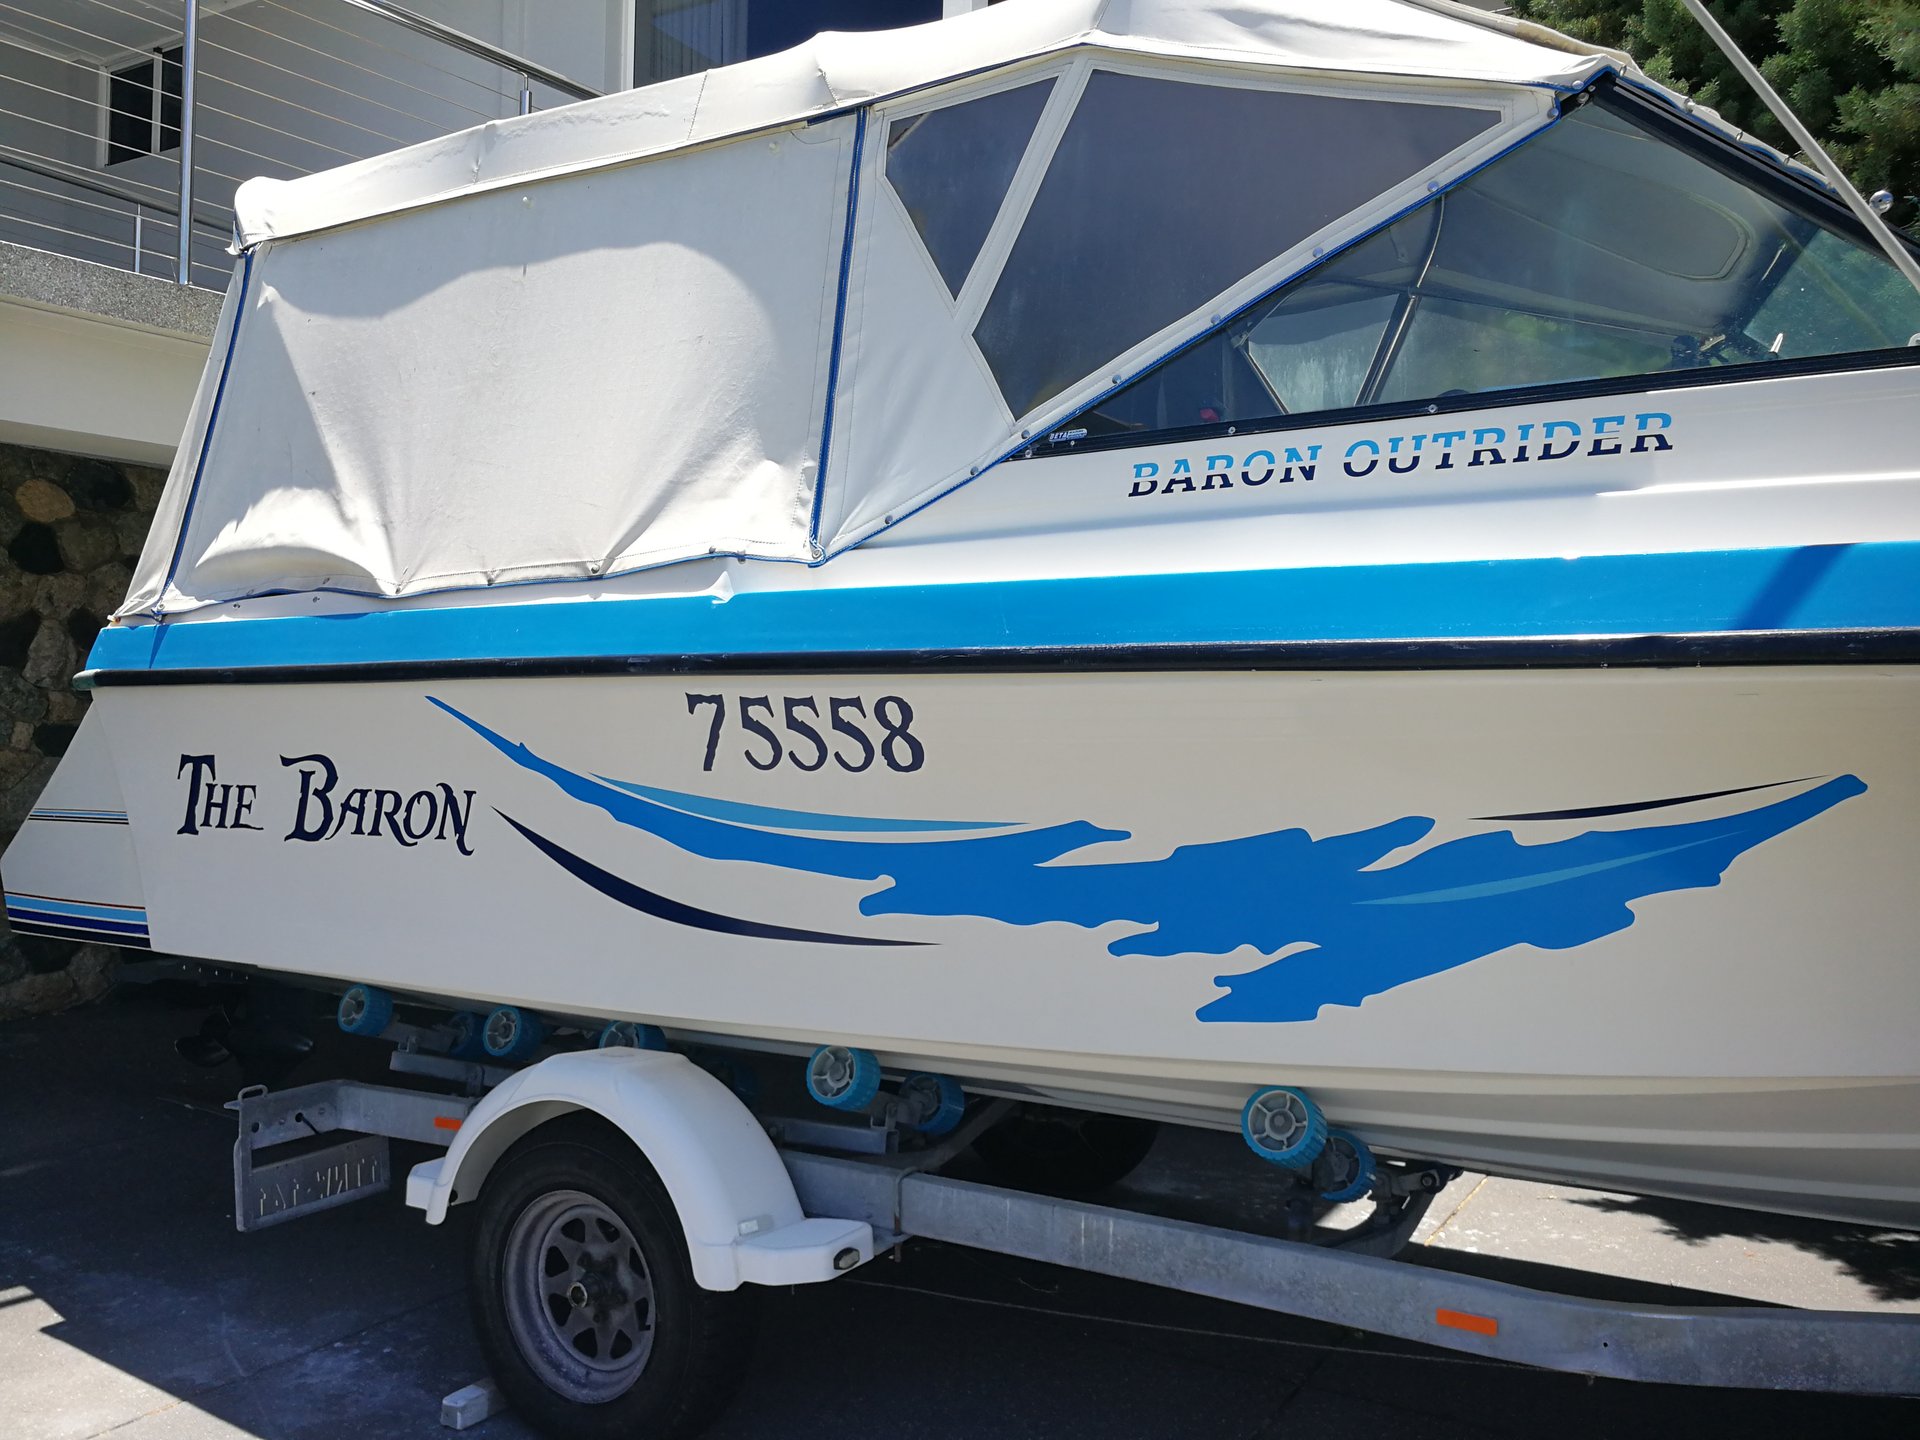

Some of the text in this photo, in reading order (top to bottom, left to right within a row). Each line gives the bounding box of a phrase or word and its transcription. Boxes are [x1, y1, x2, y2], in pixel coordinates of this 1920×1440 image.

[1128, 411, 1673, 497] BARON OUTRIDER
[685, 692, 925, 773] 75558
